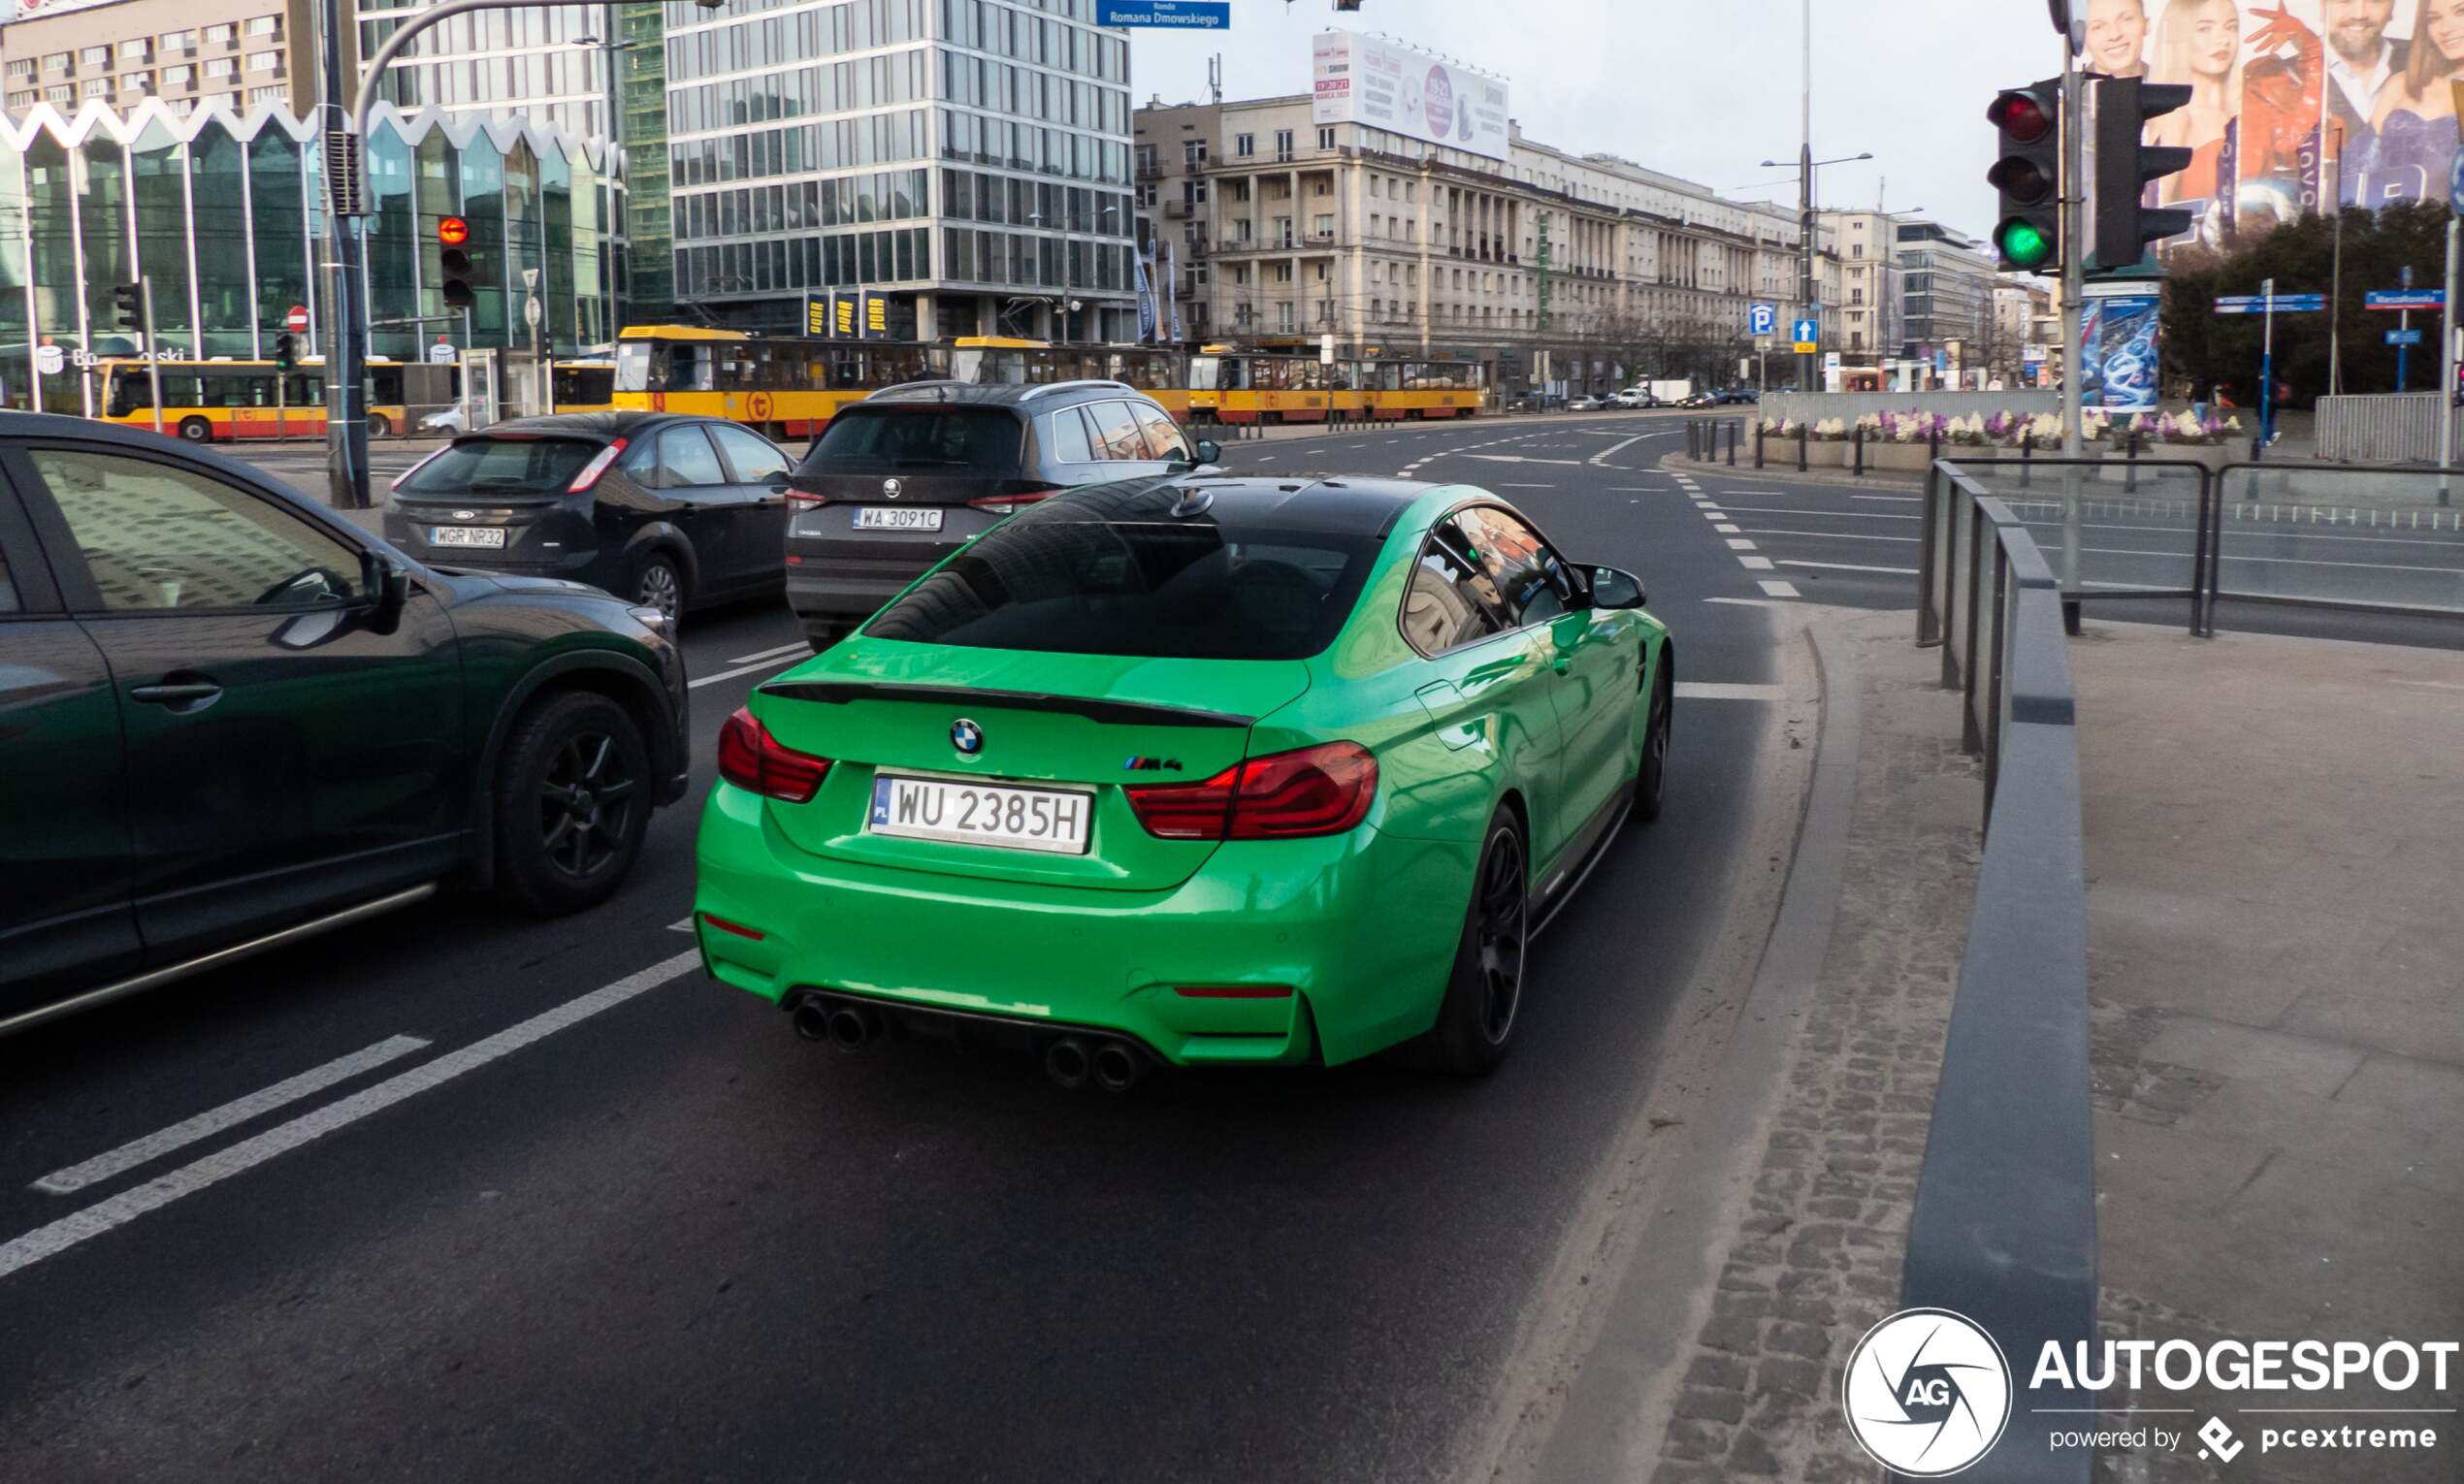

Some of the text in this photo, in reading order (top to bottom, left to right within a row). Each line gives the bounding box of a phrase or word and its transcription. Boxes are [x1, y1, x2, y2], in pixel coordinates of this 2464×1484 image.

[1152, 2, 1176, 11] Rondo
[1110, 11, 1219, 28] Romana Dmowskiego
[864, 510, 938, 527] WA 3091C
[438, 529, 503, 544] WGR NR32
[898, 784, 1078, 840] WU 2385H
